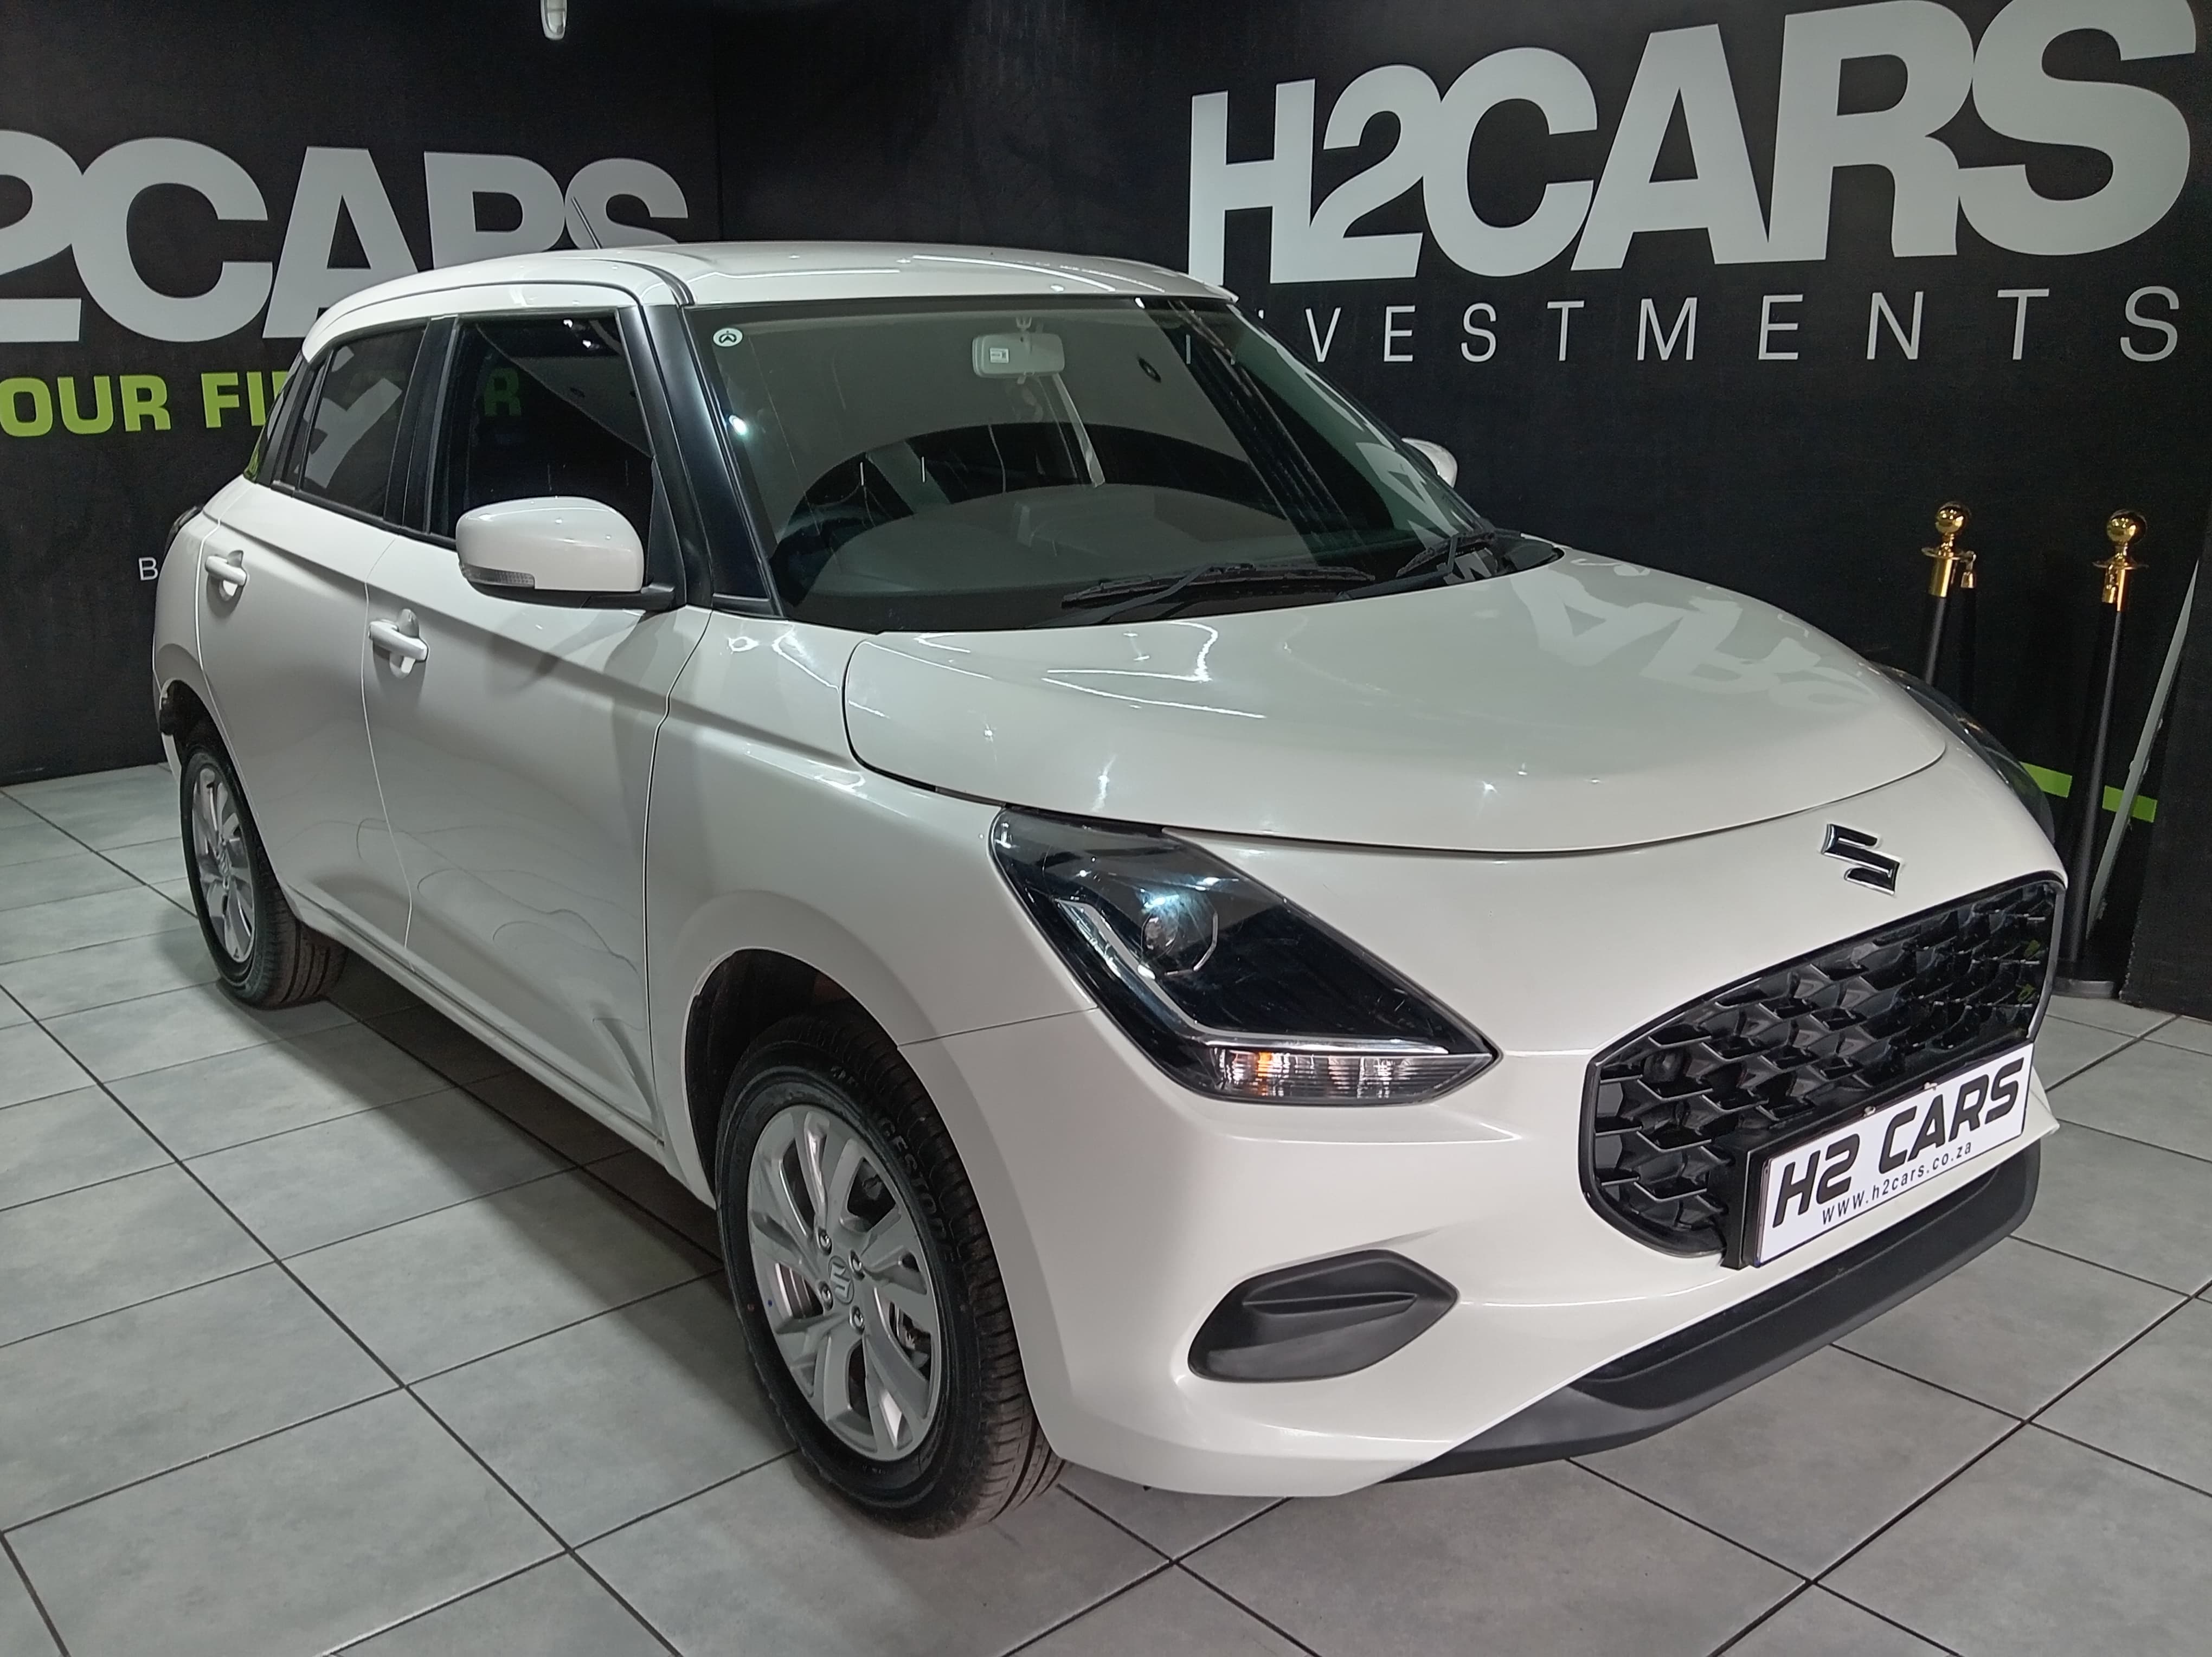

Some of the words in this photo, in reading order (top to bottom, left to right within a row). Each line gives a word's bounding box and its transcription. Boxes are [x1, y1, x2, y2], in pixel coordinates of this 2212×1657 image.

[1189, 0, 2196, 286] H2CARS
[0, 374, 171, 436] OUR
[201, 371, 288, 428] FI
[1773, 1134, 1860, 1228] H2
[1879, 1057, 2024, 1174] CARS
[1822, 1142, 1971, 1224] www.h2cars.co.za
